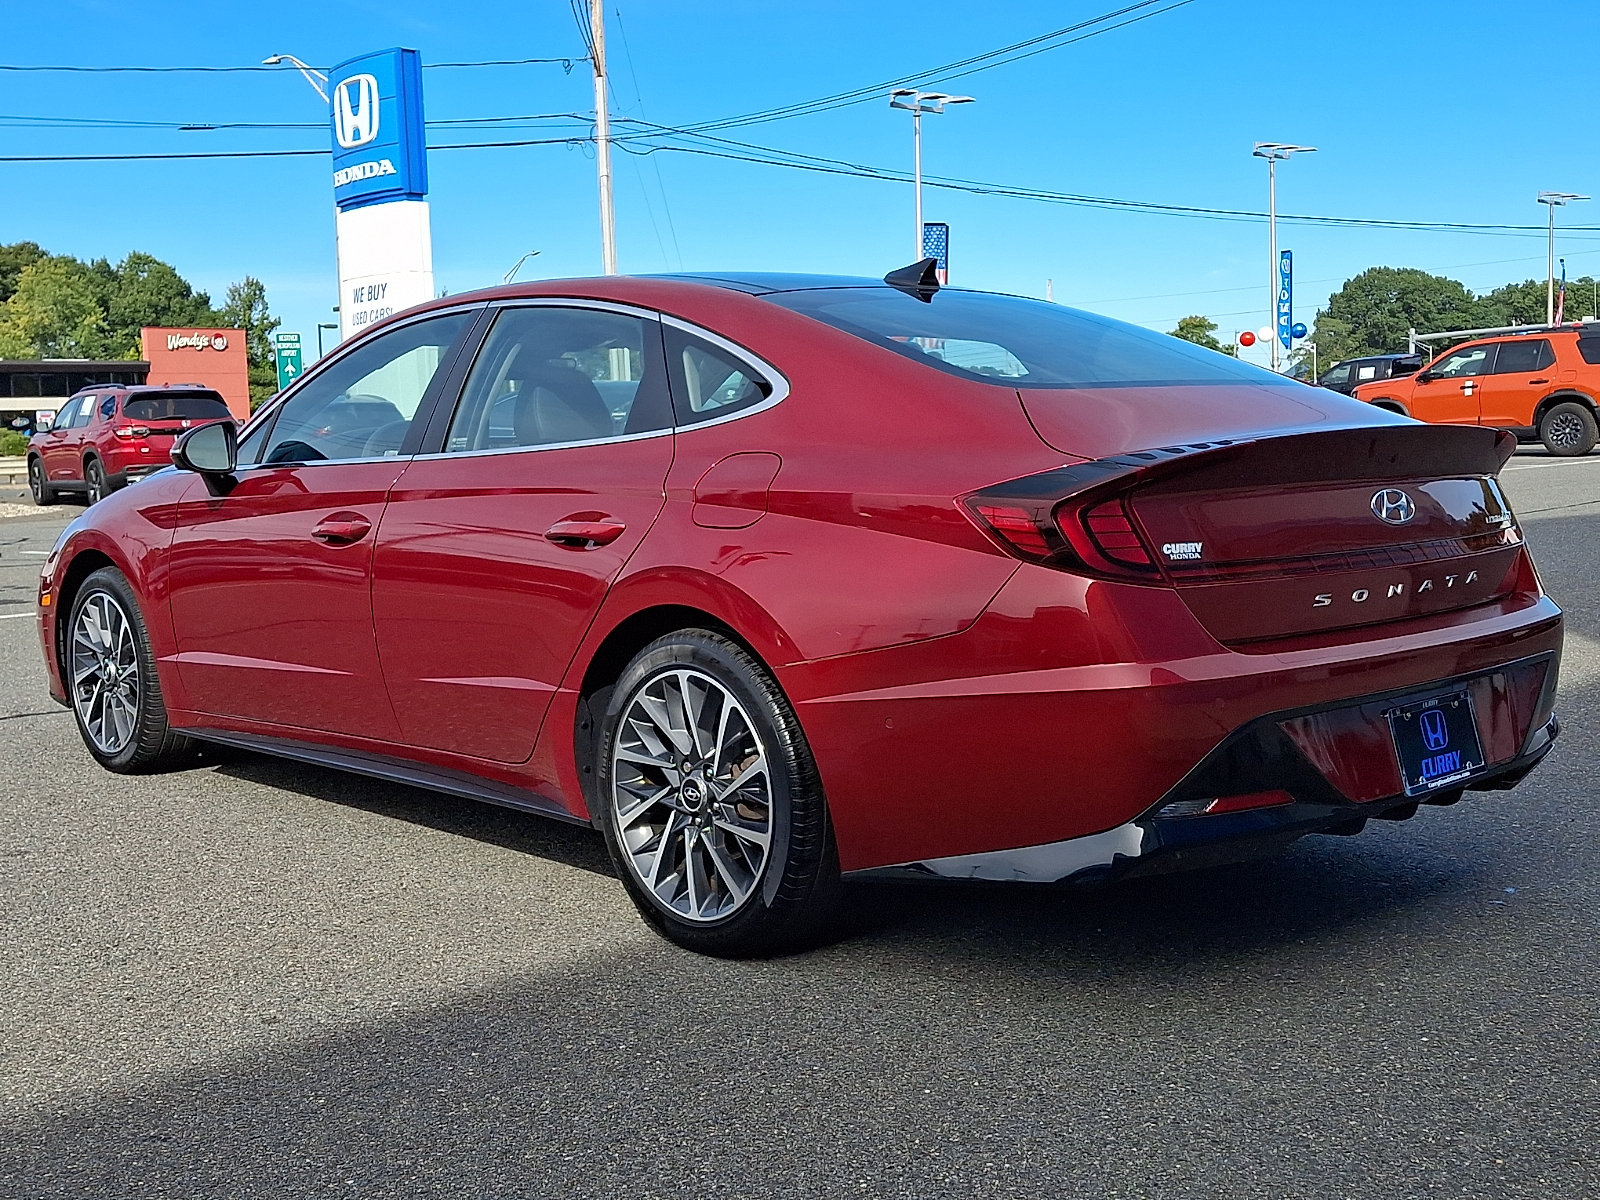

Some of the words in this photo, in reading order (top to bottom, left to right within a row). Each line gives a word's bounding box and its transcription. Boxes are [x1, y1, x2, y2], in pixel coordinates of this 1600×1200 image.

[333, 159, 397, 188] HONDA
[353, 286, 364, 304] WE
[367, 282, 387, 302] BUY
[352, 310, 368, 326] USED
[167, 331, 209, 350] Wendy's
[1162, 543, 1203, 555] CURRY
[1170, 552, 1202, 560] HONDA
[1312, 570, 1479, 608] SONATA
[1421, 750, 1461, 779] CURRY
